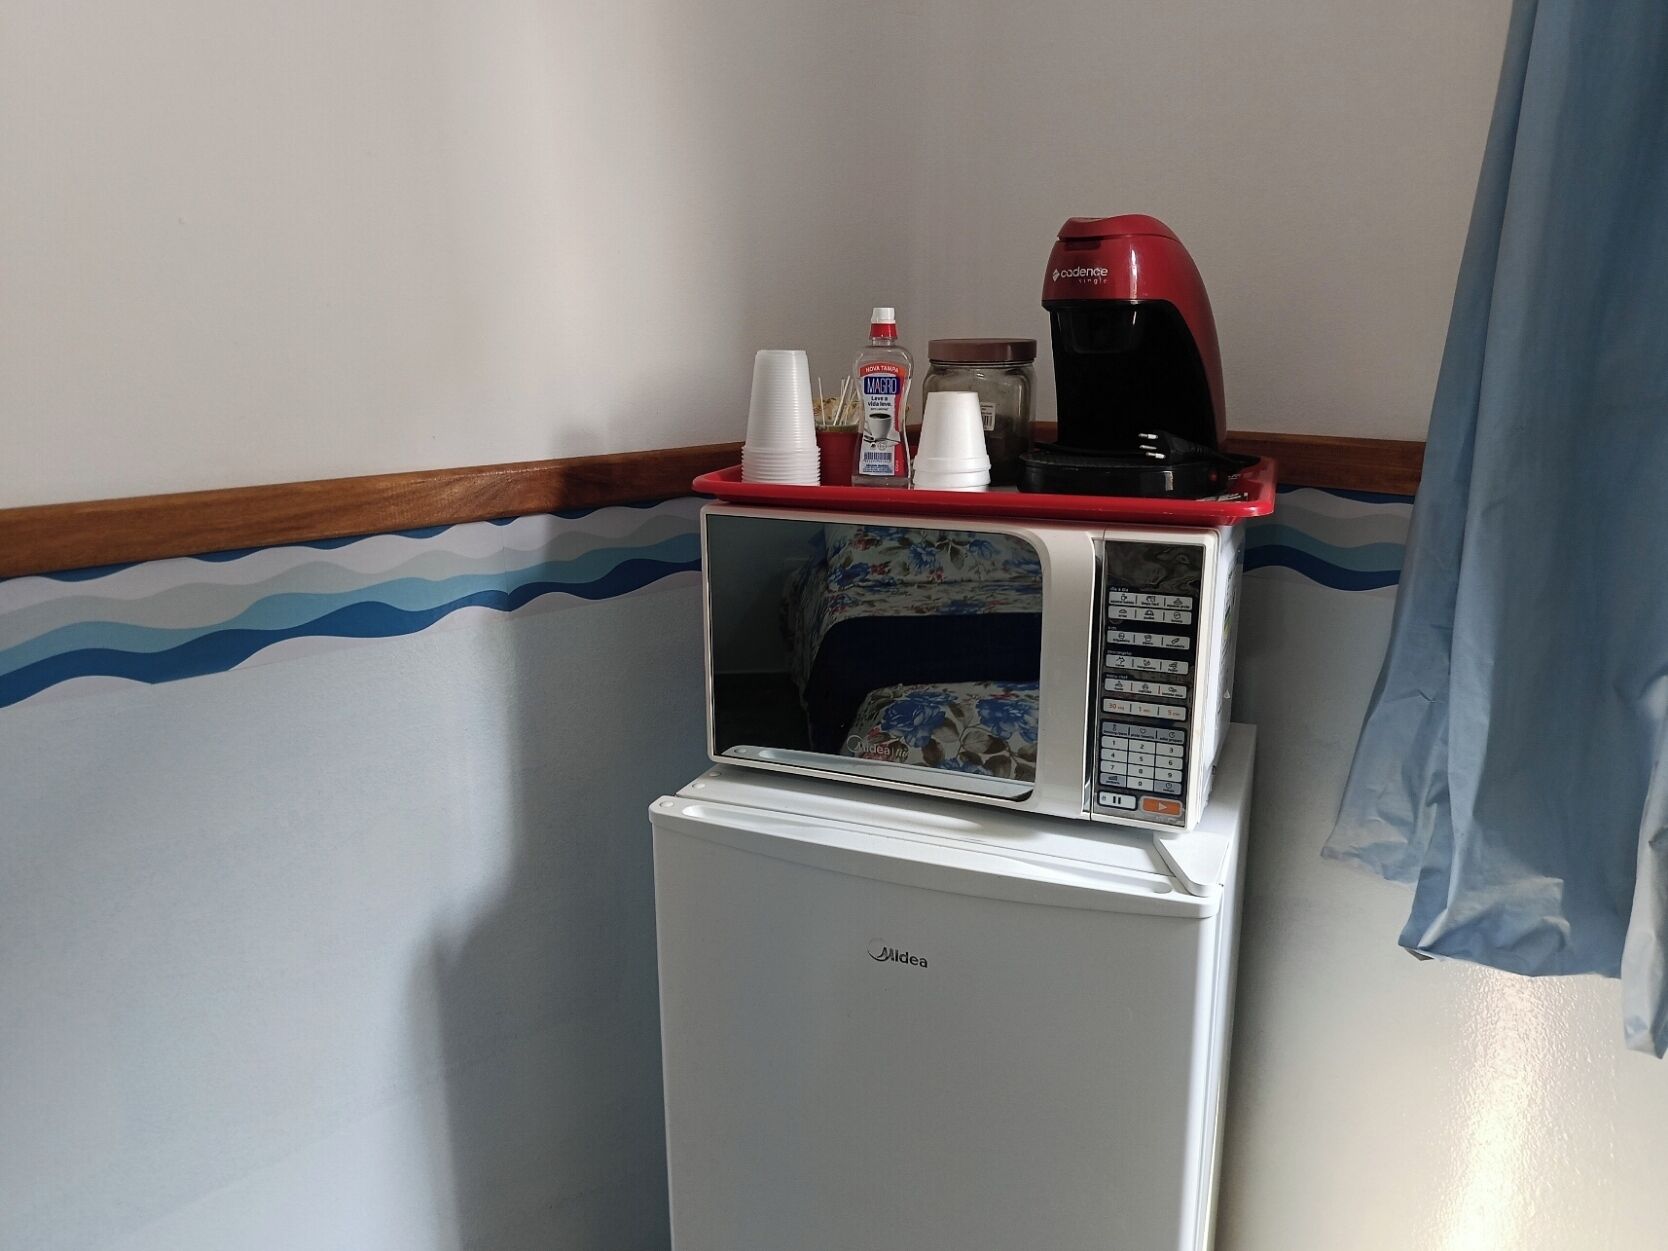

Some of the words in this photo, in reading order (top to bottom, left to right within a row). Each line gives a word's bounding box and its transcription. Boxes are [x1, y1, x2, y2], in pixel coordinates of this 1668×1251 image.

[1060, 266, 1108, 278] cadence
[865, 365, 880, 373] NOVA
[881, 365, 899, 373] TAMPA
[867, 377, 897, 394] MAGRO
[867, 943, 928, 968] Midea
